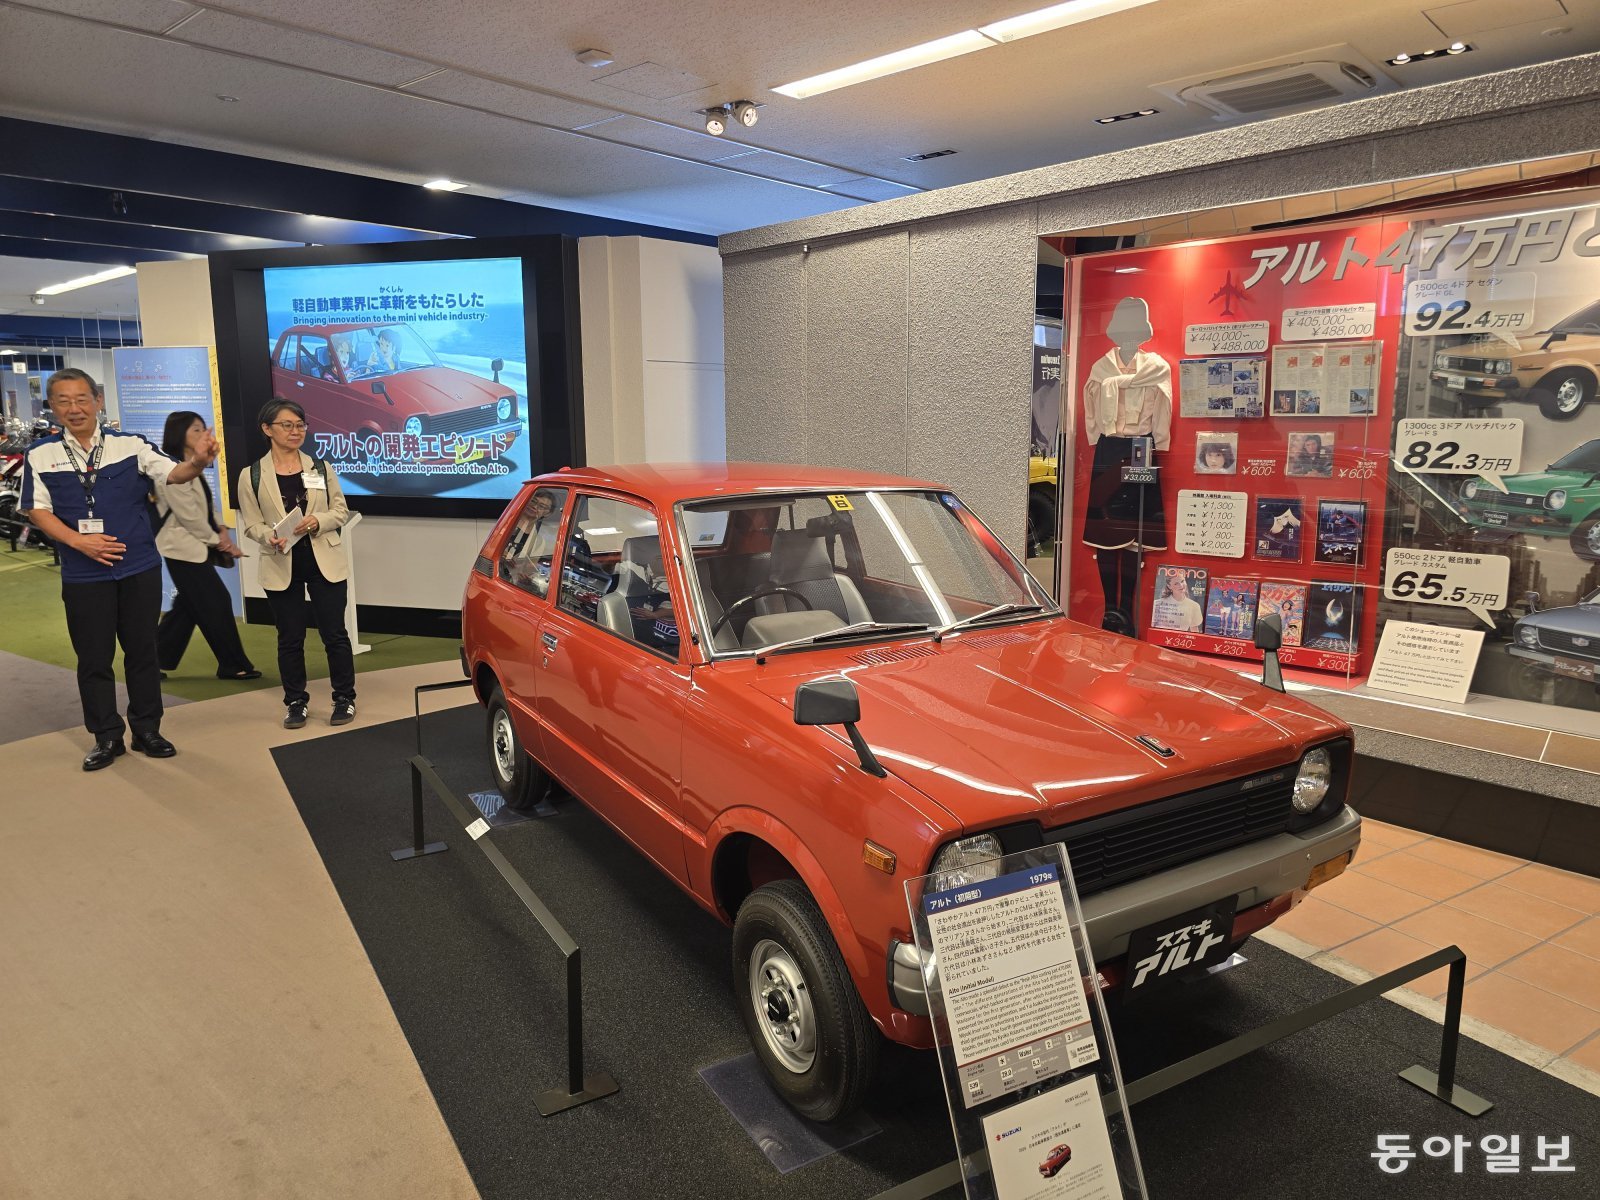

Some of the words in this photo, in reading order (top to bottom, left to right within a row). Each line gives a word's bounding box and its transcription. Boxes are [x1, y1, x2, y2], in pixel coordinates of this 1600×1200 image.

[1415, 283, 1448, 291] 1500cc
[1451, 280, 1473, 289] 4ドア
[1478, 278, 1503, 287] セダン
[292, 292, 484, 313] 軽自動車業界に革新をもたらした
[293, 316, 326, 326] Bringing
[328, 314, 371, 323] innovation
[383, 314, 396, 322] the
[399, 313, 416, 321] mini
[418, 312, 447, 321] vehicle
[1413, 300, 1525, 331] 92.4万円
[1311, 324, 1371, 337] ¥488,000
[1211, 340, 1265, 352] ¥488,000
[1404, 422, 1437, 430] 1300cc
[1440, 422, 1462, 430] 3ドア
[1465, 422, 1517, 430] ハッチバック
[314, 432, 507, 460] アルトの開発エピソード
[1402, 441, 1512, 471] 82.3万円
[332, 461, 366, 475] episode
[367, 462, 377, 473] in
[379, 462, 395, 473] the
[395, 462, 457, 475] development
[458, 463, 467, 474] of
[470, 463, 486, 474] the
[488, 463, 508, 474] Alto
[1241, 466, 1275, 476] ¥600-
[1394, 552, 1420, 560] 550cc
[1423, 554, 1446, 562] 2ドア
[1448, 555, 1482, 565] 軽自動車
[1421, 561, 1447, 569] カスタム
[1391, 571, 1499, 606] 65.5万円
[1213, 643, 1247, 656] ¥230-
[1155, 919, 1212, 952] スズキ
[1132, 933, 1225, 988] アルト
[1001, 1126, 1022, 1139] SUZUKI
